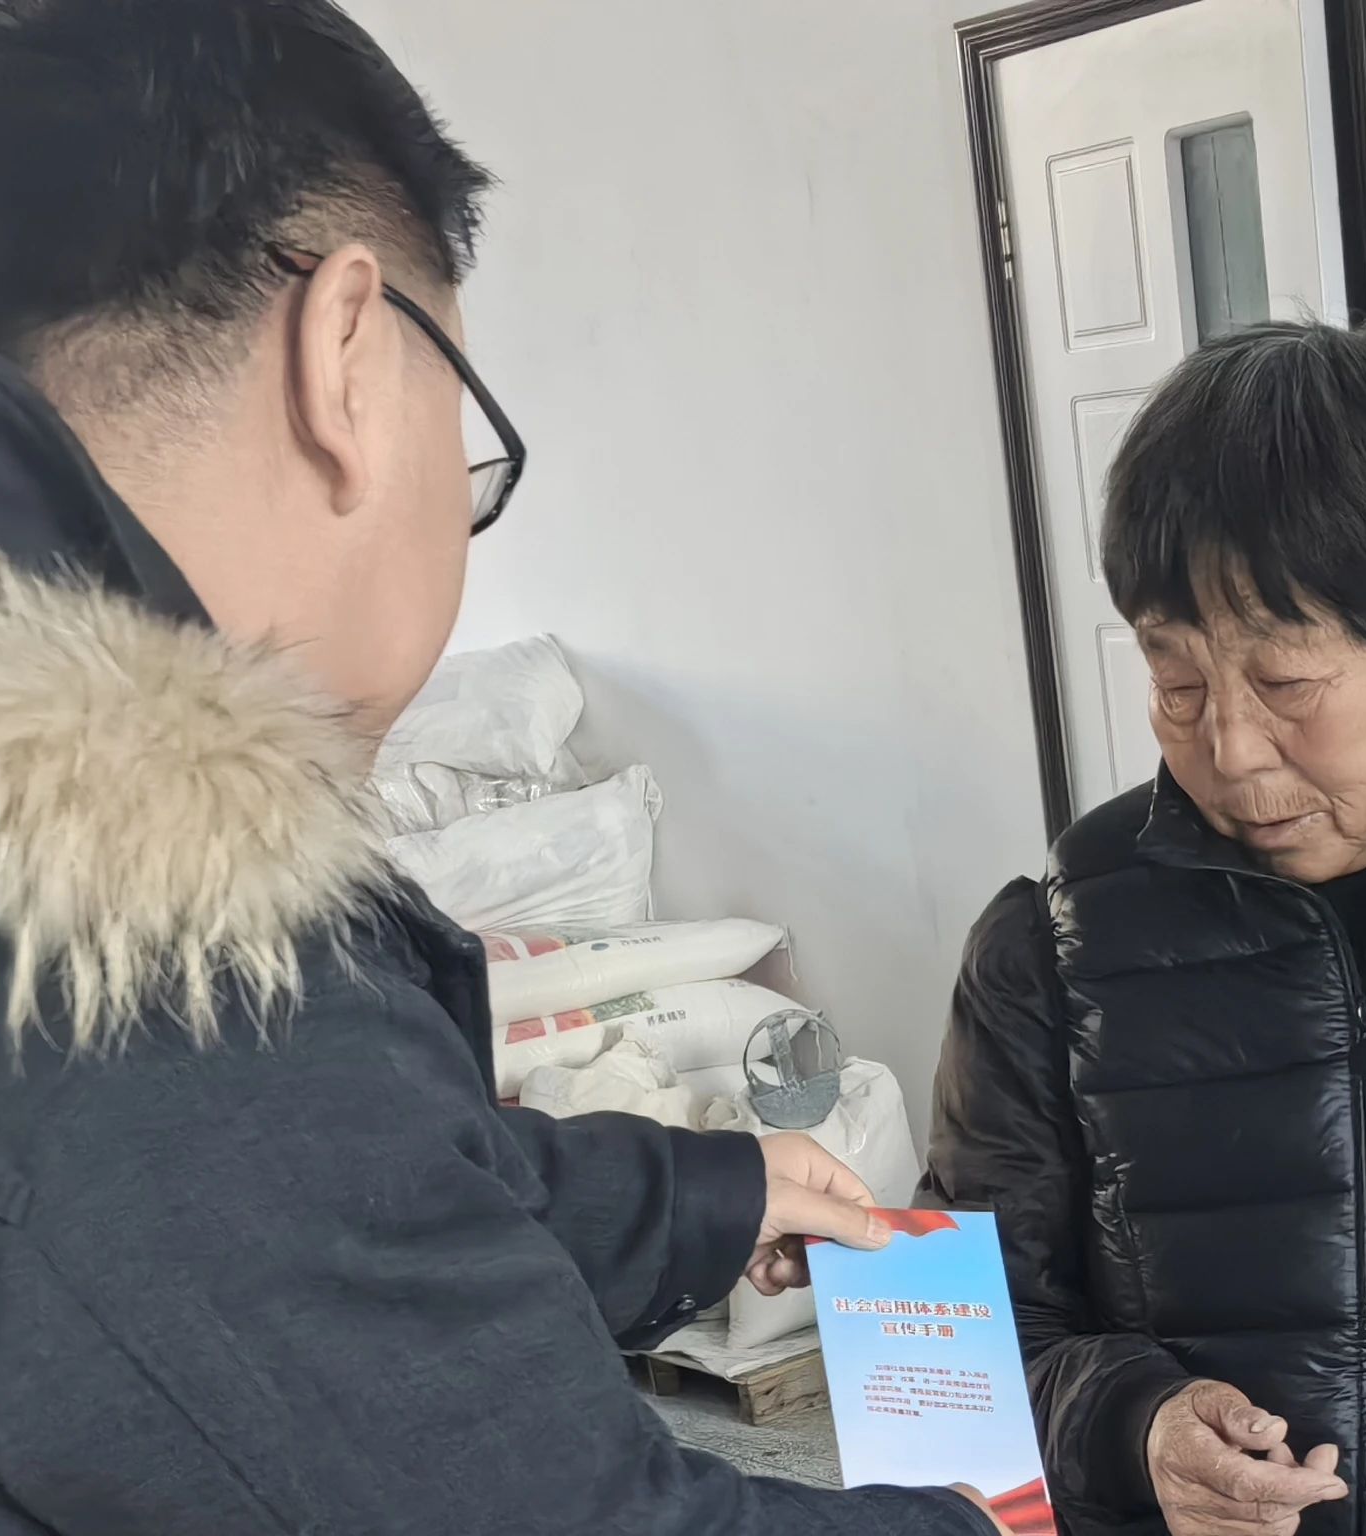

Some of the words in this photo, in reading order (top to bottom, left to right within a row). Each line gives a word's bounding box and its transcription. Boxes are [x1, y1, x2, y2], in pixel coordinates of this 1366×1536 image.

[834, 1297, 993, 1319] 社会信用体系建设
[880, 1321, 955, 1339] 宣传手册
